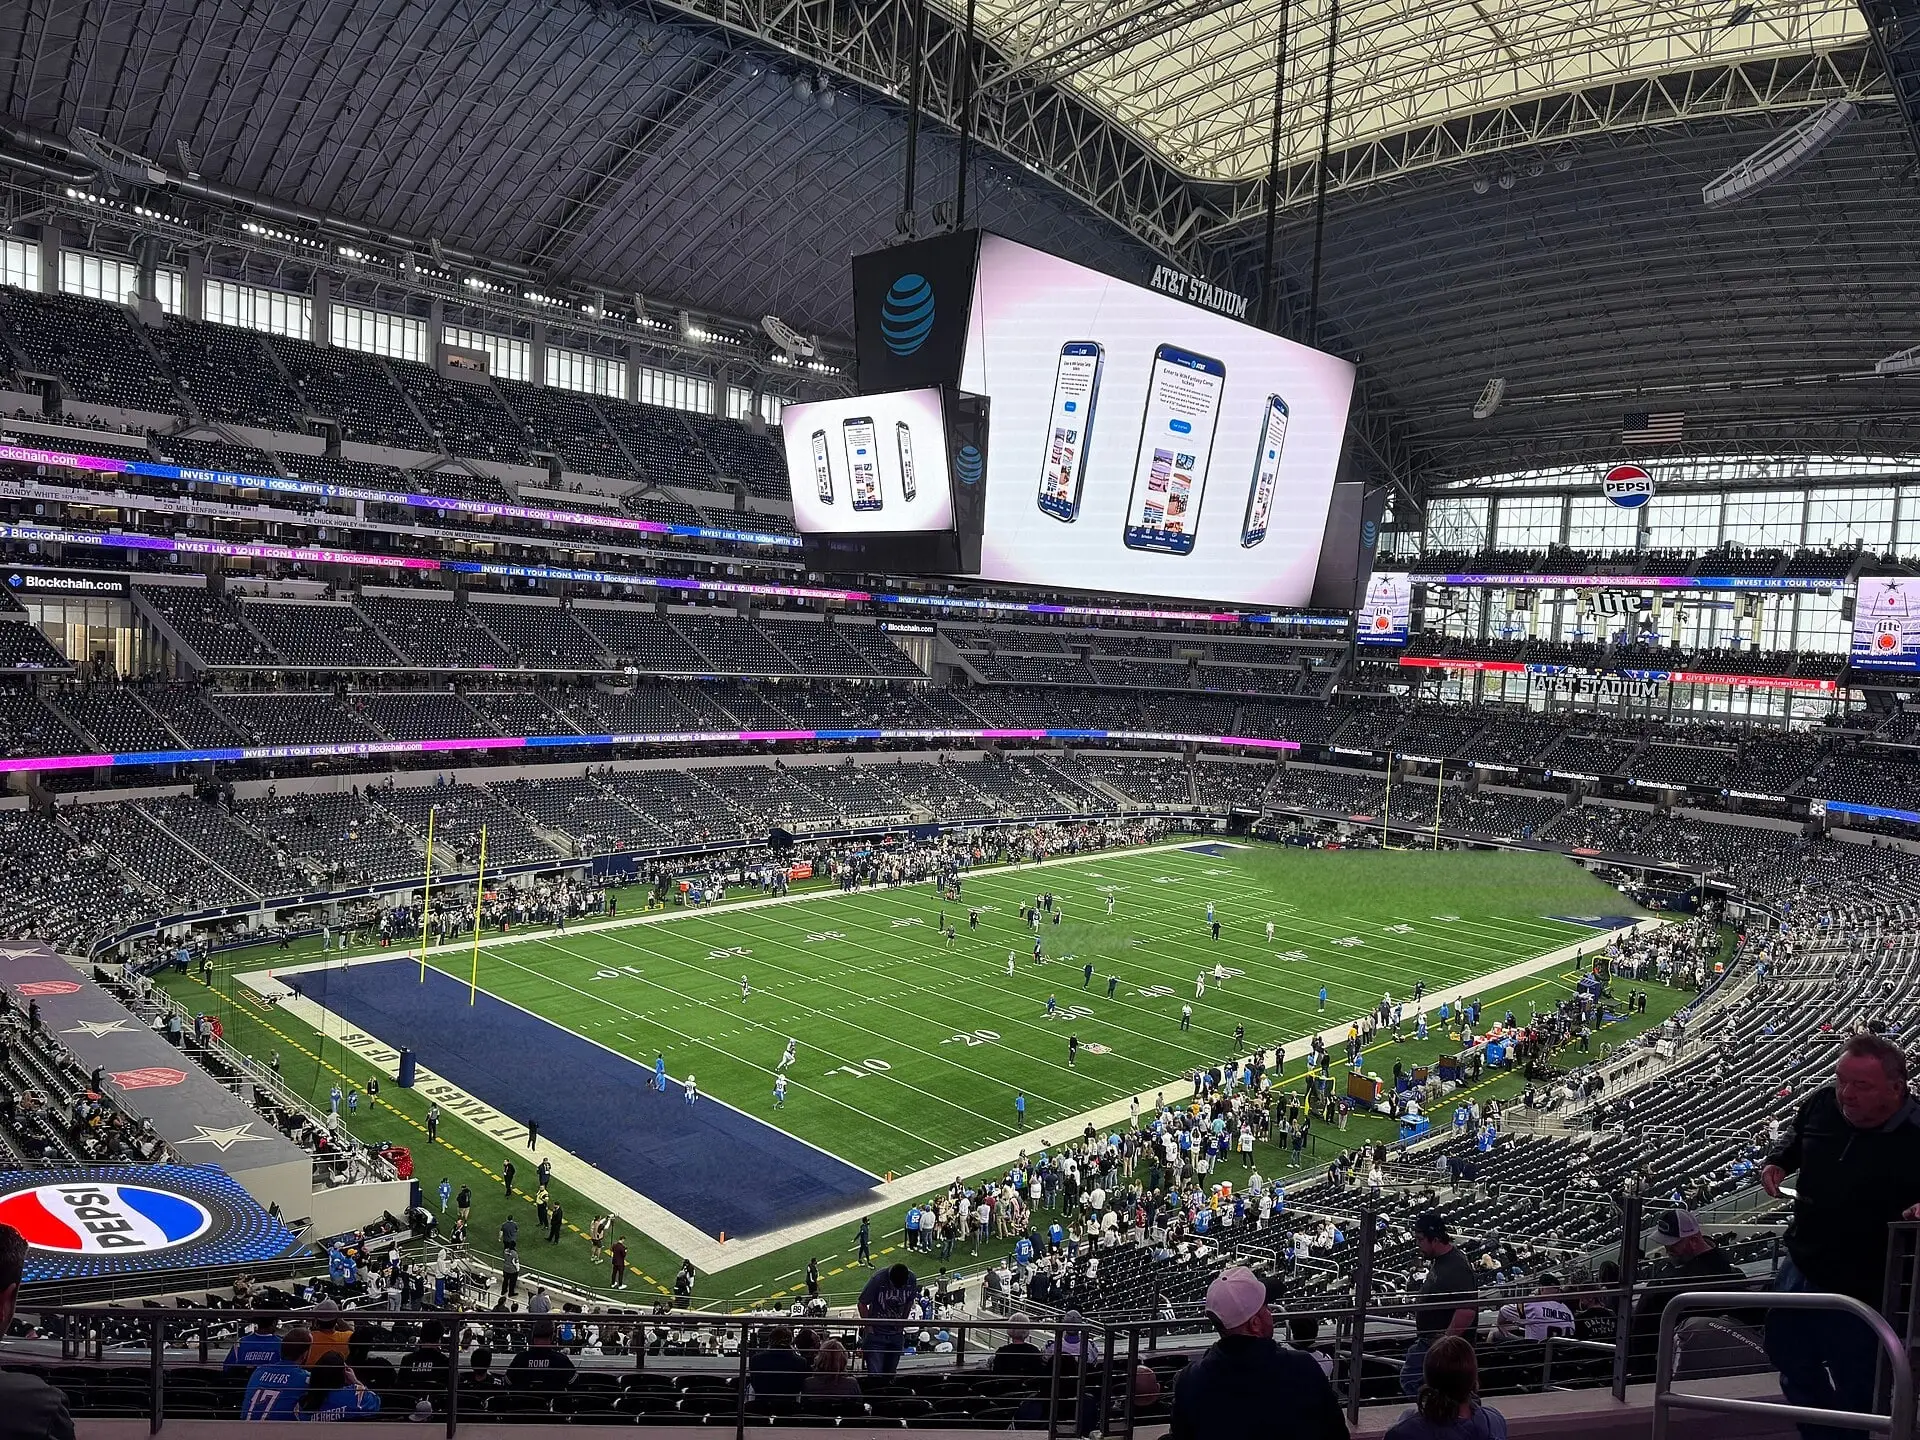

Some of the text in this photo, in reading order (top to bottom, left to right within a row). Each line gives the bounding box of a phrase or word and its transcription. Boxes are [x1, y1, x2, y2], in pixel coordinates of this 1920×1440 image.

[1150, 265, 1249, 319] AT&T STADIUM
[180, 470, 408, 502] INVEST LIKE YOUR ICONS WITH Blockchain.com
[1606, 481, 1650, 492] PEPSI
[3, 488, 60, 500] RANDY WHITE
[176, 505, 190, 513] MEL
[191, 506, 217, 515] RENFRO
[458, 502, 488, 512] INVEST
[488, 505, 503, 513] LIKE
[504, 506, 525, 516] YOUR
[527, 508, 550, 519] ICONS
[583, 514, 639, 529] Blockchain.com
[314, 518, 333, 526] CHUCK
[334, 521, 357, 529] HOWLEY
[11, 528, 102, 544] Blockchain.com
[700, 529, 721, 538] INVEST
[174, 542, 403, 566] INVEST LIKE YOUR ICONS WITH Blockchain.com
[481, 566, 508, 574] INVEST
[527, 569, 547, 577] YOUR
[550, 571, 572, 579] ICONS
[574, 572, 592, 581] WITH
[1511, 576, 1524, 584] LIKE
[1546, 577, 1567, 585] ICONS
[26, 575, 123, 592] Blockchain.com
[1591, 592, 1642, 617] Lite
[888, 623, 934, 633] Blockchain.com
[1878, 621, 1900, 633] Lite
[1535, 676, 1657, 698] AT&T STADIUM
[1726, 676, 1739, 684] JOY
[243, 742, 422, 757] INVEST LIKE YOUR ICONS WITH Blockchain.com
[1552, 770, 1600, 782] Blockchain.com
[1636, 779, 1687, 792] Blockchain.com
[1729, 789, 1786, 803] Blockchain.com
[708, 946, 753, 960] 20
[596, 965, 645, 980] 10
[955, 1028, 1002, 1048] 20
[838, 1058, 892, 1079] 10
[339, 1033, 528, 1142] IT TAKES OF US
[55, 1187, 146, 1248] PEPSI
[1021, 1246, 1029, 1255] 10
[244, 1351, 275, 1361] HERBERT
[528, 1359, 550, 1368] ROMO
[259, 1371, 291, 1384] RIVERS
[246, 1389, 281, 1420] 17
